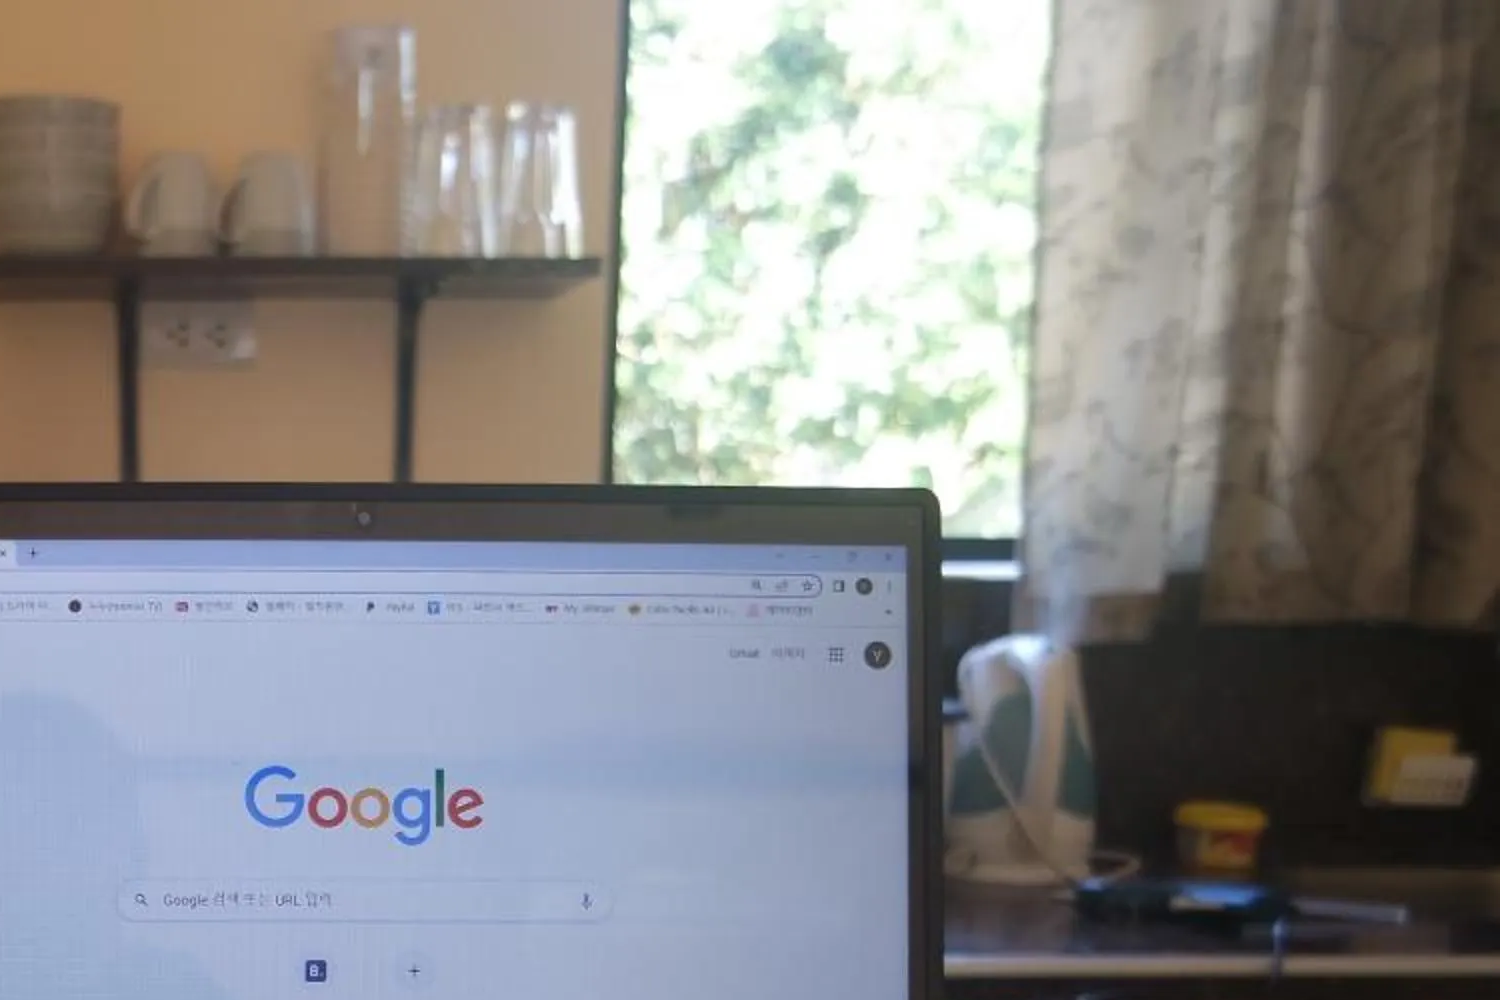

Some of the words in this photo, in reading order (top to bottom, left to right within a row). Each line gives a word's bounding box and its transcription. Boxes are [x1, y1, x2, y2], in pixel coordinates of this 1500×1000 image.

[244, 765, 484, 846] Google
[163, 892, 209, 910] Google
[275, 893, 301, 908] URL
